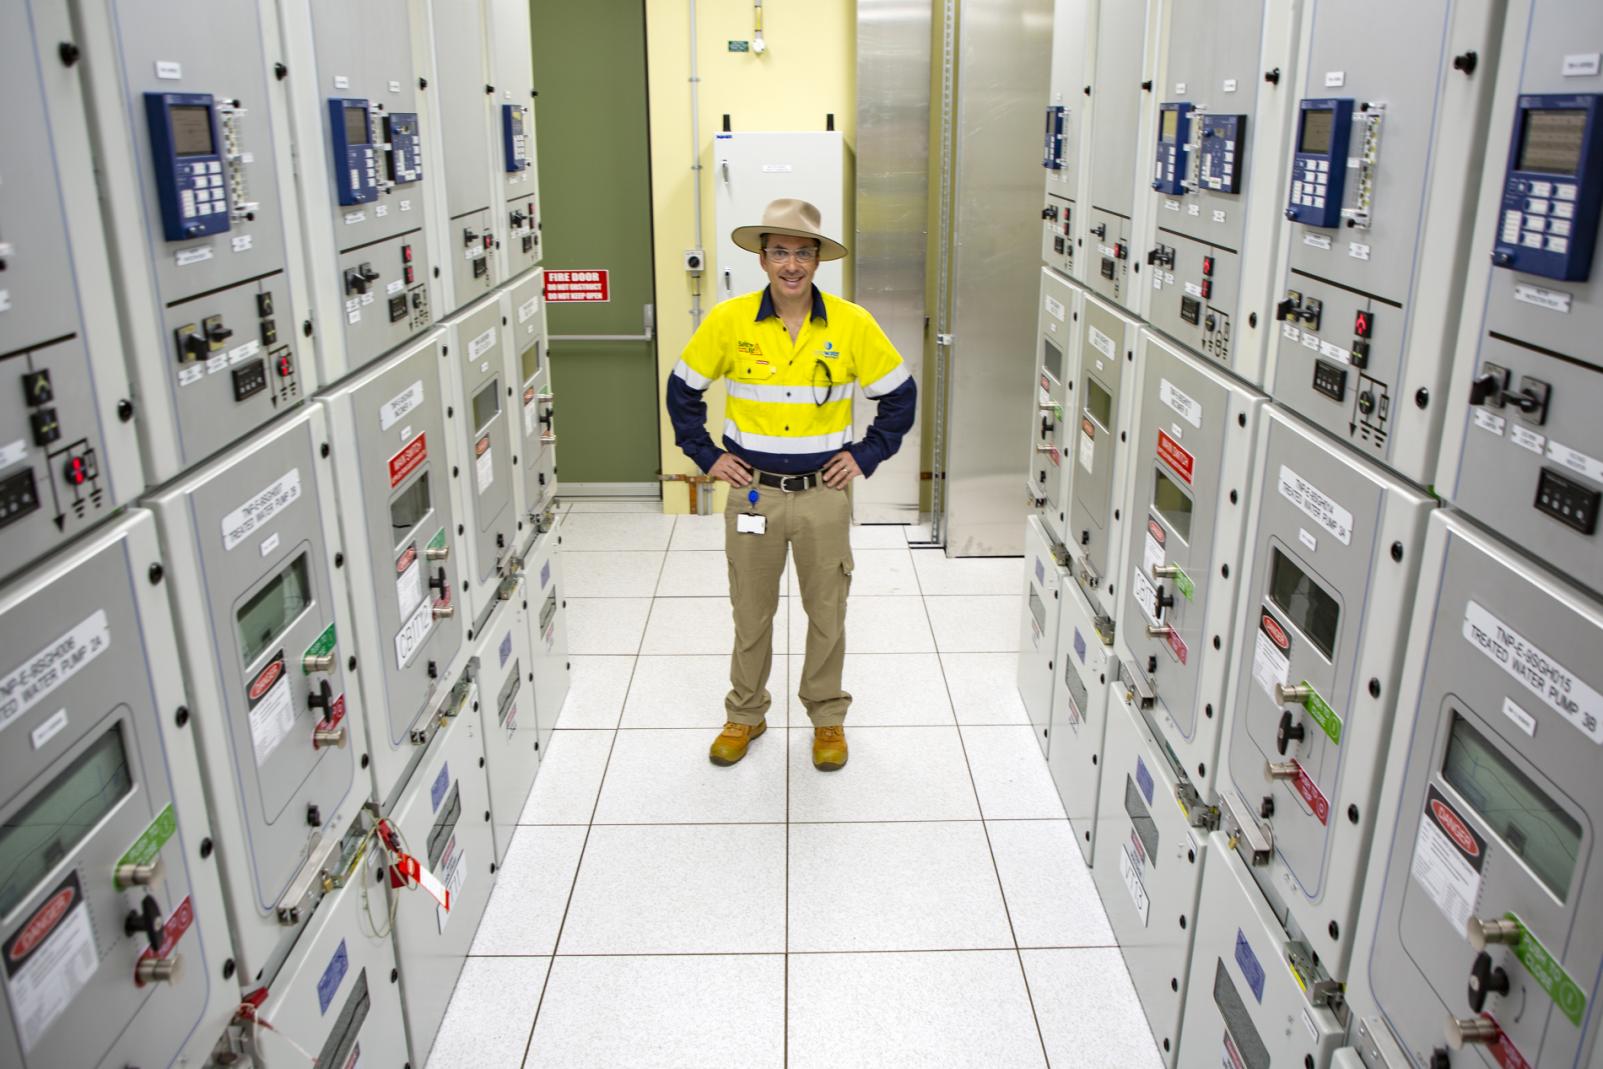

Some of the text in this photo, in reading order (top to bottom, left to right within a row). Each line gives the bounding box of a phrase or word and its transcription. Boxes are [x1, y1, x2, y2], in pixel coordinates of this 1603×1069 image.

[548, 272, 599, 282] FIRE DOOR
[547, 283, 557, 291] DO
[558, 283, 569, 291] NOT
[547, 292, 558, 300] DO
[558, 292, 569, 300] NOT
[1322, 512, 1337, 529] PUMP
[22, 667, 58, 702] WATER
[61, 646, 86, 675] PUMP
[1471, 624, 1597, 733] TREATED WATER PUMP 3B
